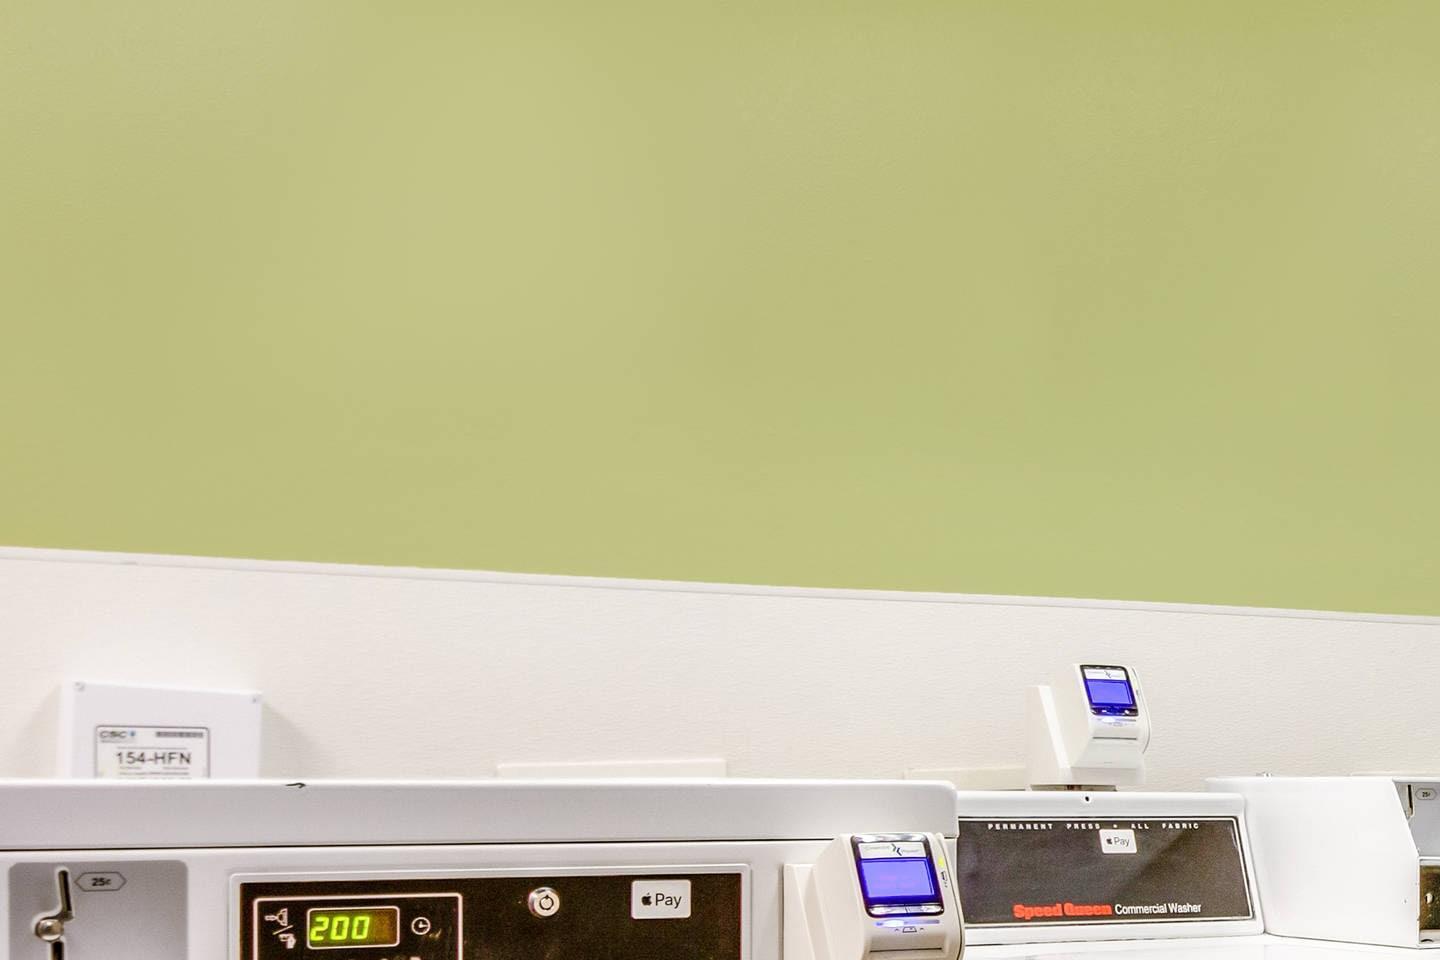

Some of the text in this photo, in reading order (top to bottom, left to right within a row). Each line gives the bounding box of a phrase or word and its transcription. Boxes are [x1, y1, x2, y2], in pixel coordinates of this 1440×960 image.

[116, 752, 191, 764] 154-HFN
[1113, 837, 1130, 846] Pay
[655, 893, 682, 909] Pay
[1013, 903, 1202, 919] Speed Queen Commercial Washer
[309, 916, 371, 941] 200
